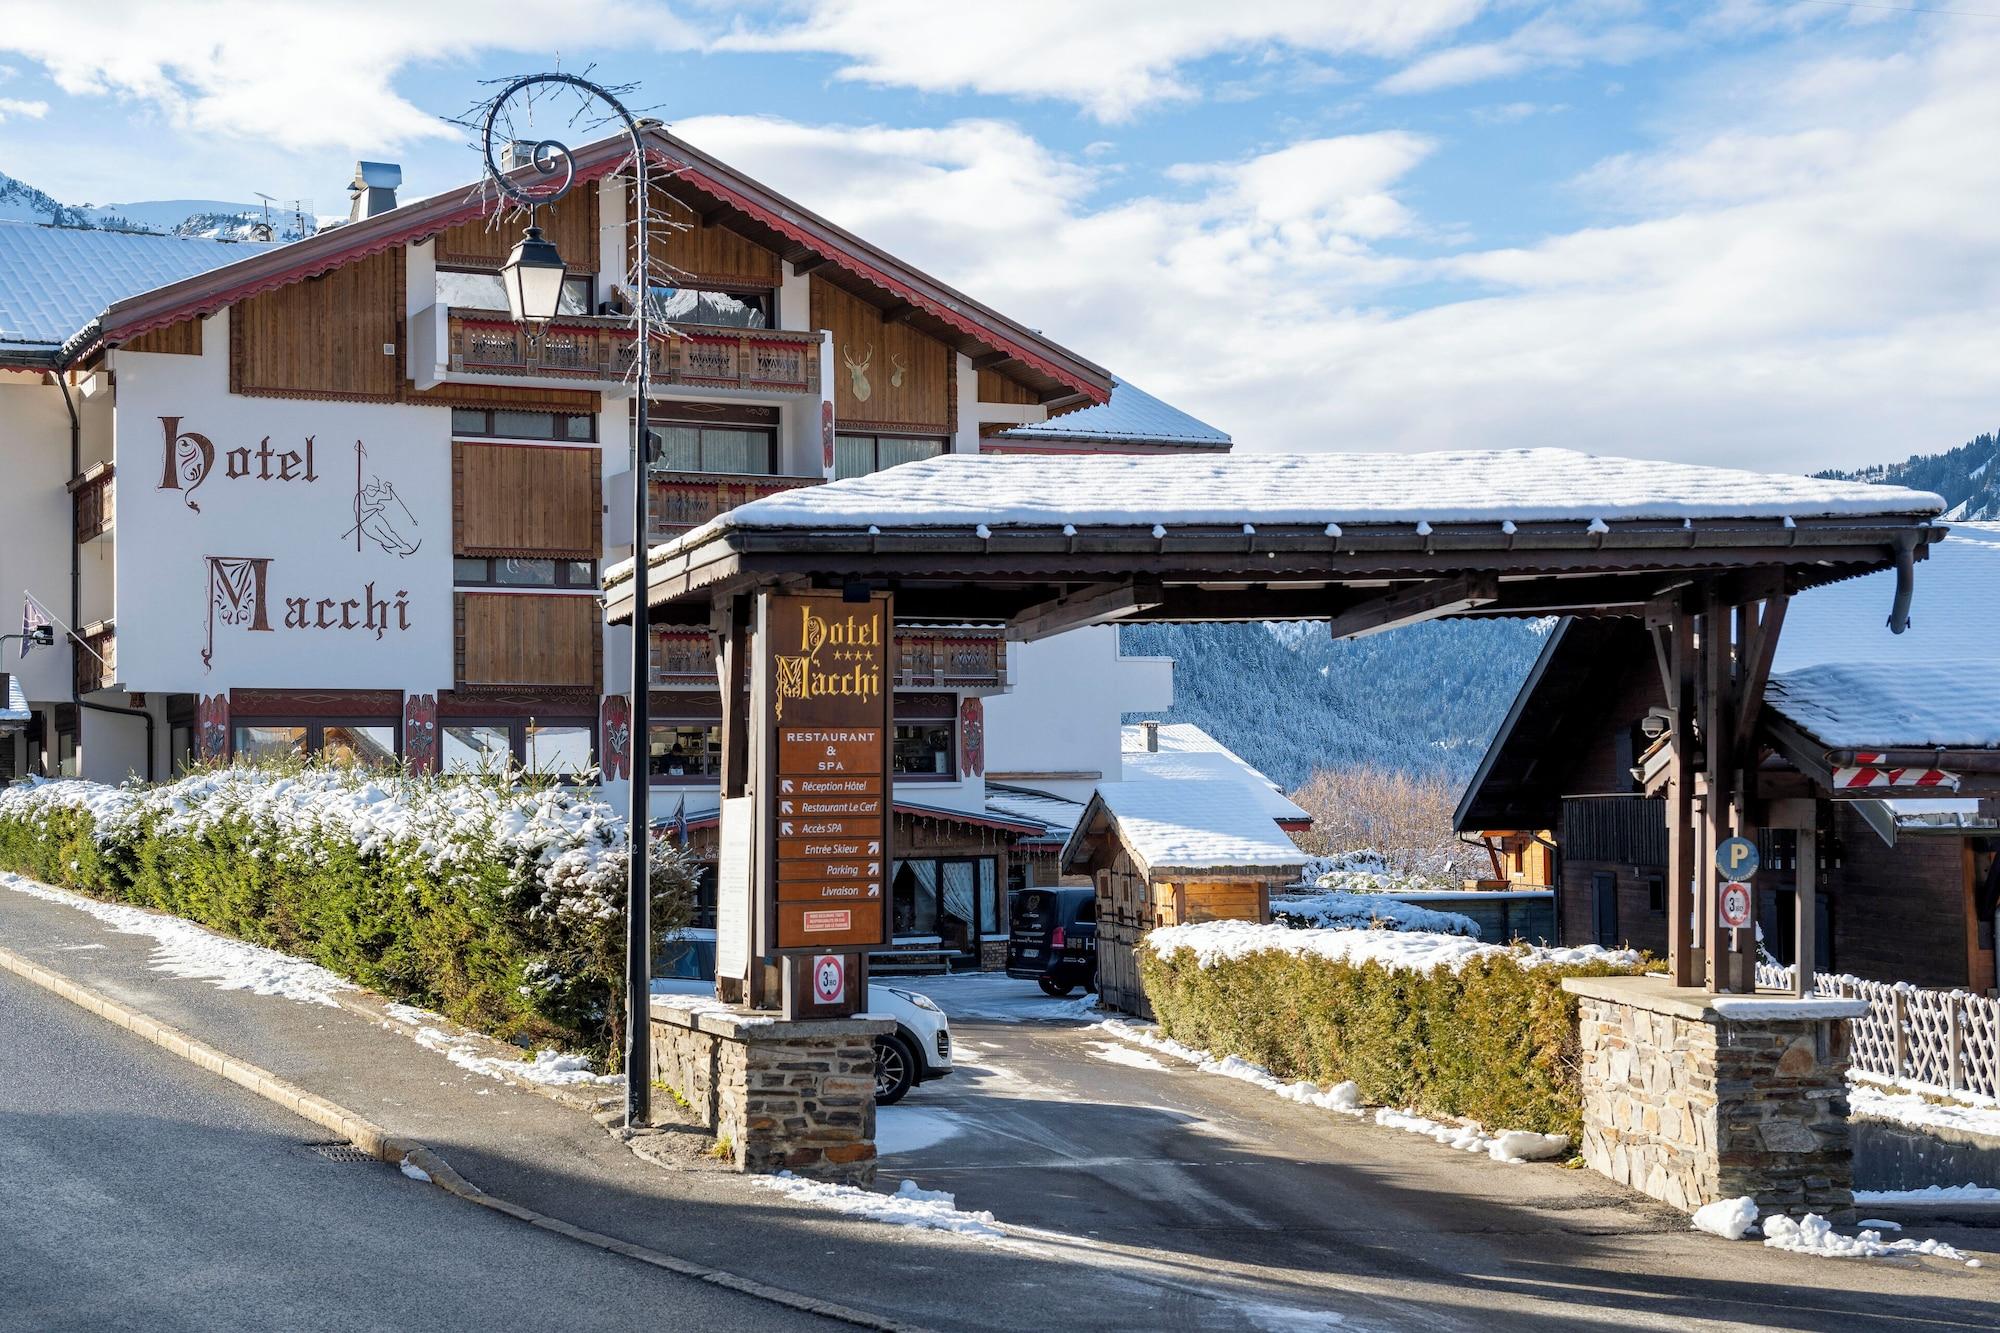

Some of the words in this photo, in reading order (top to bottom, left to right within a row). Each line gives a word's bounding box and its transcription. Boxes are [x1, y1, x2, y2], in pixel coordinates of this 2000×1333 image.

[201, 554, 411, 673] Macchi
[775, 654, 880, 721] Macchi
[787, 732, 875, 742] RESTAURANT
[826, 745, 837, 756] &
[818, 761, 844, 771] SPA
[802, 781, 843, 793] Réception
[844, 780, 867, 791] Hôtel
[802, 802, 848, 813] Restaurant
[849, 802, 859, 812] Le
[860, 801, 878, 812] Cerf
[802, 823, 826, 833] Accès
[826, 823, 842, 833] SPA
[805, 844, 832, 855] Entrée
[832, 844, 859, 854] Skieur
[1730, 843, 1749, 869] P
[826, 865, 859, 877] Parking
[821, 886, 859, 897] Livraison
[1729, 897, 1735, 912] 3
[823, 971, 829, 987] 3
